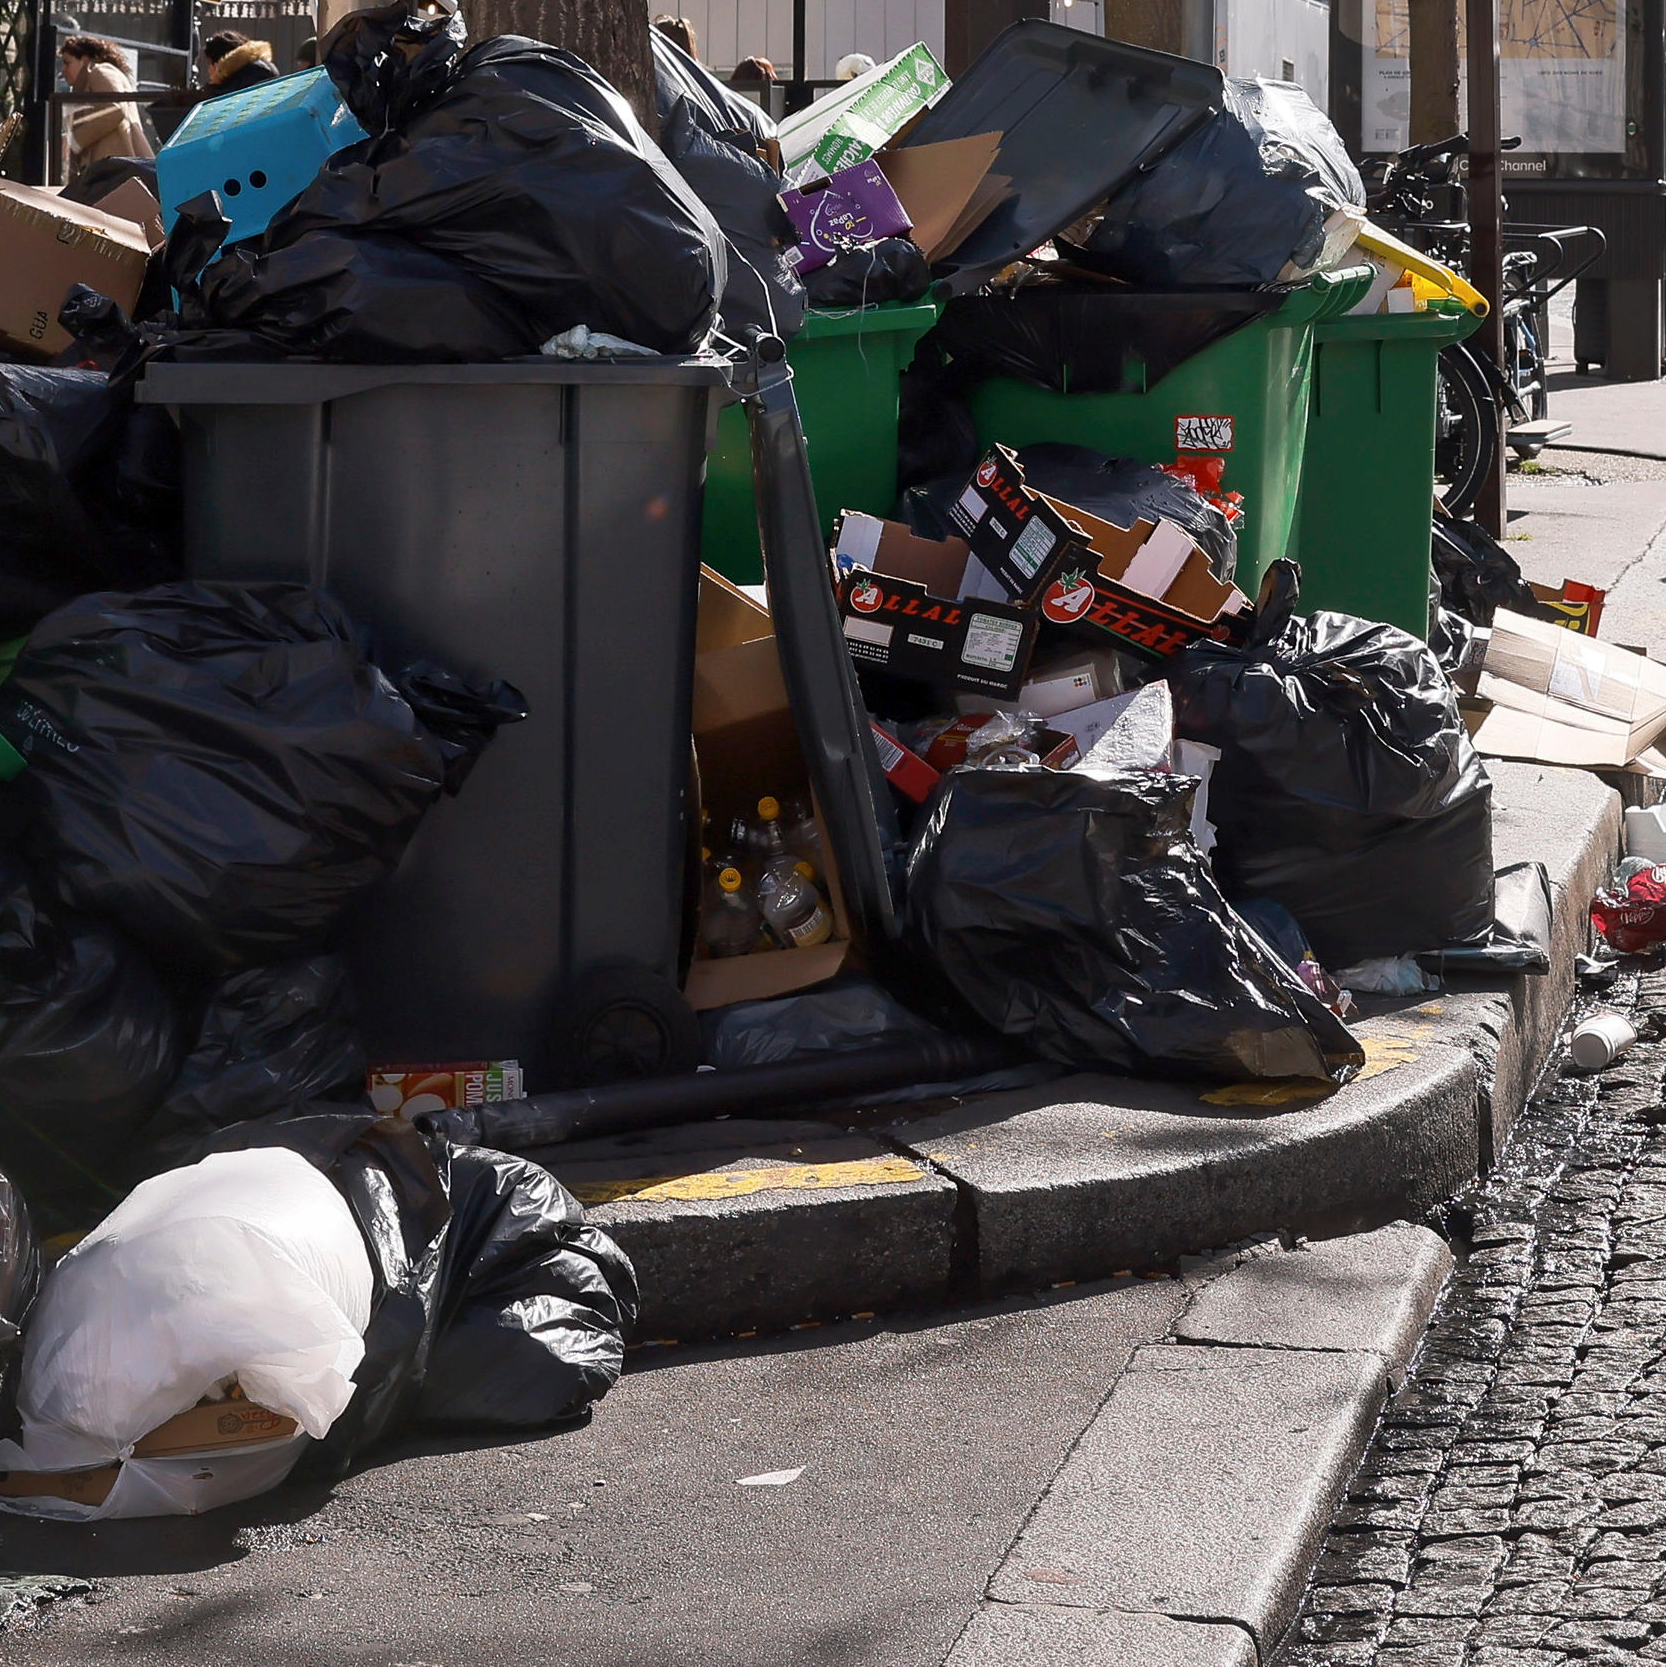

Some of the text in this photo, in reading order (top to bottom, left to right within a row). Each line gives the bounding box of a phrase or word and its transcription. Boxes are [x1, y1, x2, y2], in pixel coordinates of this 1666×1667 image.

[855, 587, 962, 625] ALLAL
[1051, 587, 1187, 654] ALLAL
[957, 674, 980, 683] PRODUIT
[989, 680, 1008, 689] MAROC
[486, 1074, 502, 1102] JUS
